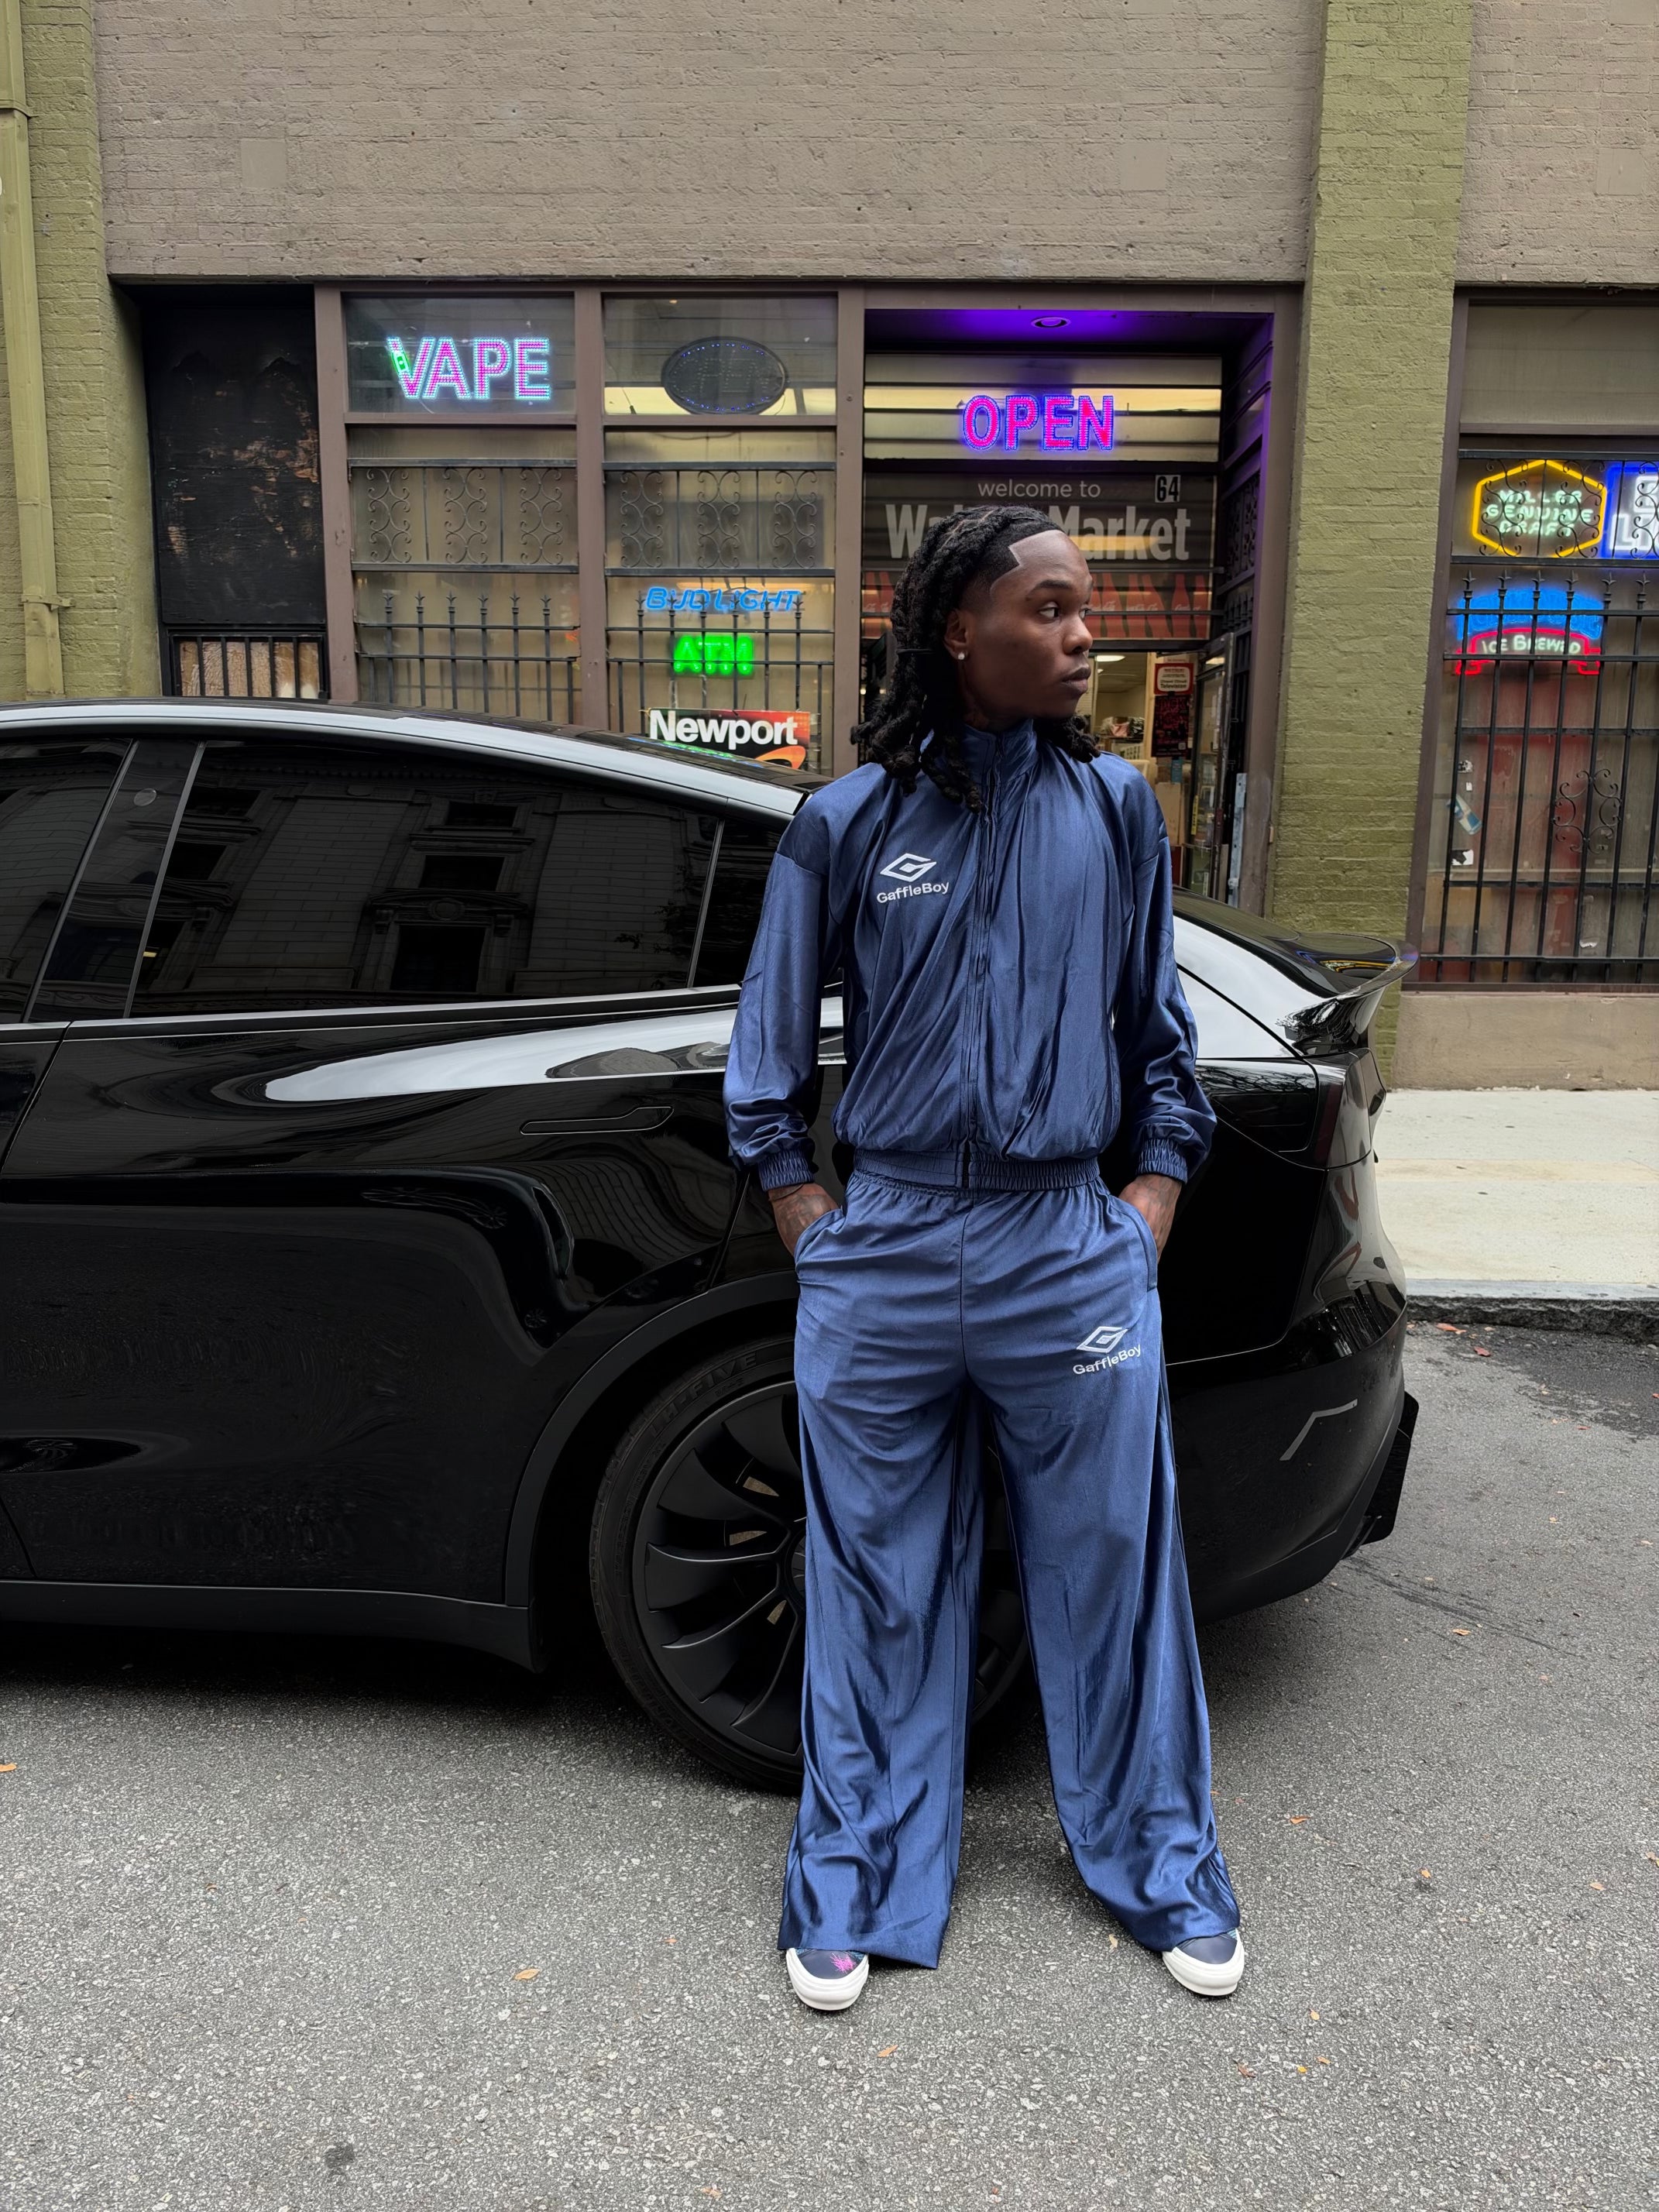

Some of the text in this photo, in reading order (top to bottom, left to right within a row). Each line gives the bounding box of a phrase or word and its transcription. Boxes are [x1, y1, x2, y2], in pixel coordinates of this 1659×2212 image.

[386, 336, 551, 400] VAPE
[963, 394, 1114, 451] OPEN
[977, 479, 1101, 498] welcome to
[1156, 476, 1179, 502] 64
[1049, 505, 1190, 561] Market
[673, 635, 754, 675] ATM
[650, 709, 798, 750] Newport
[876, 881, 950, 904] GaffleBoy
[1072, 1344, 1142, 1376] GaffleBoy
